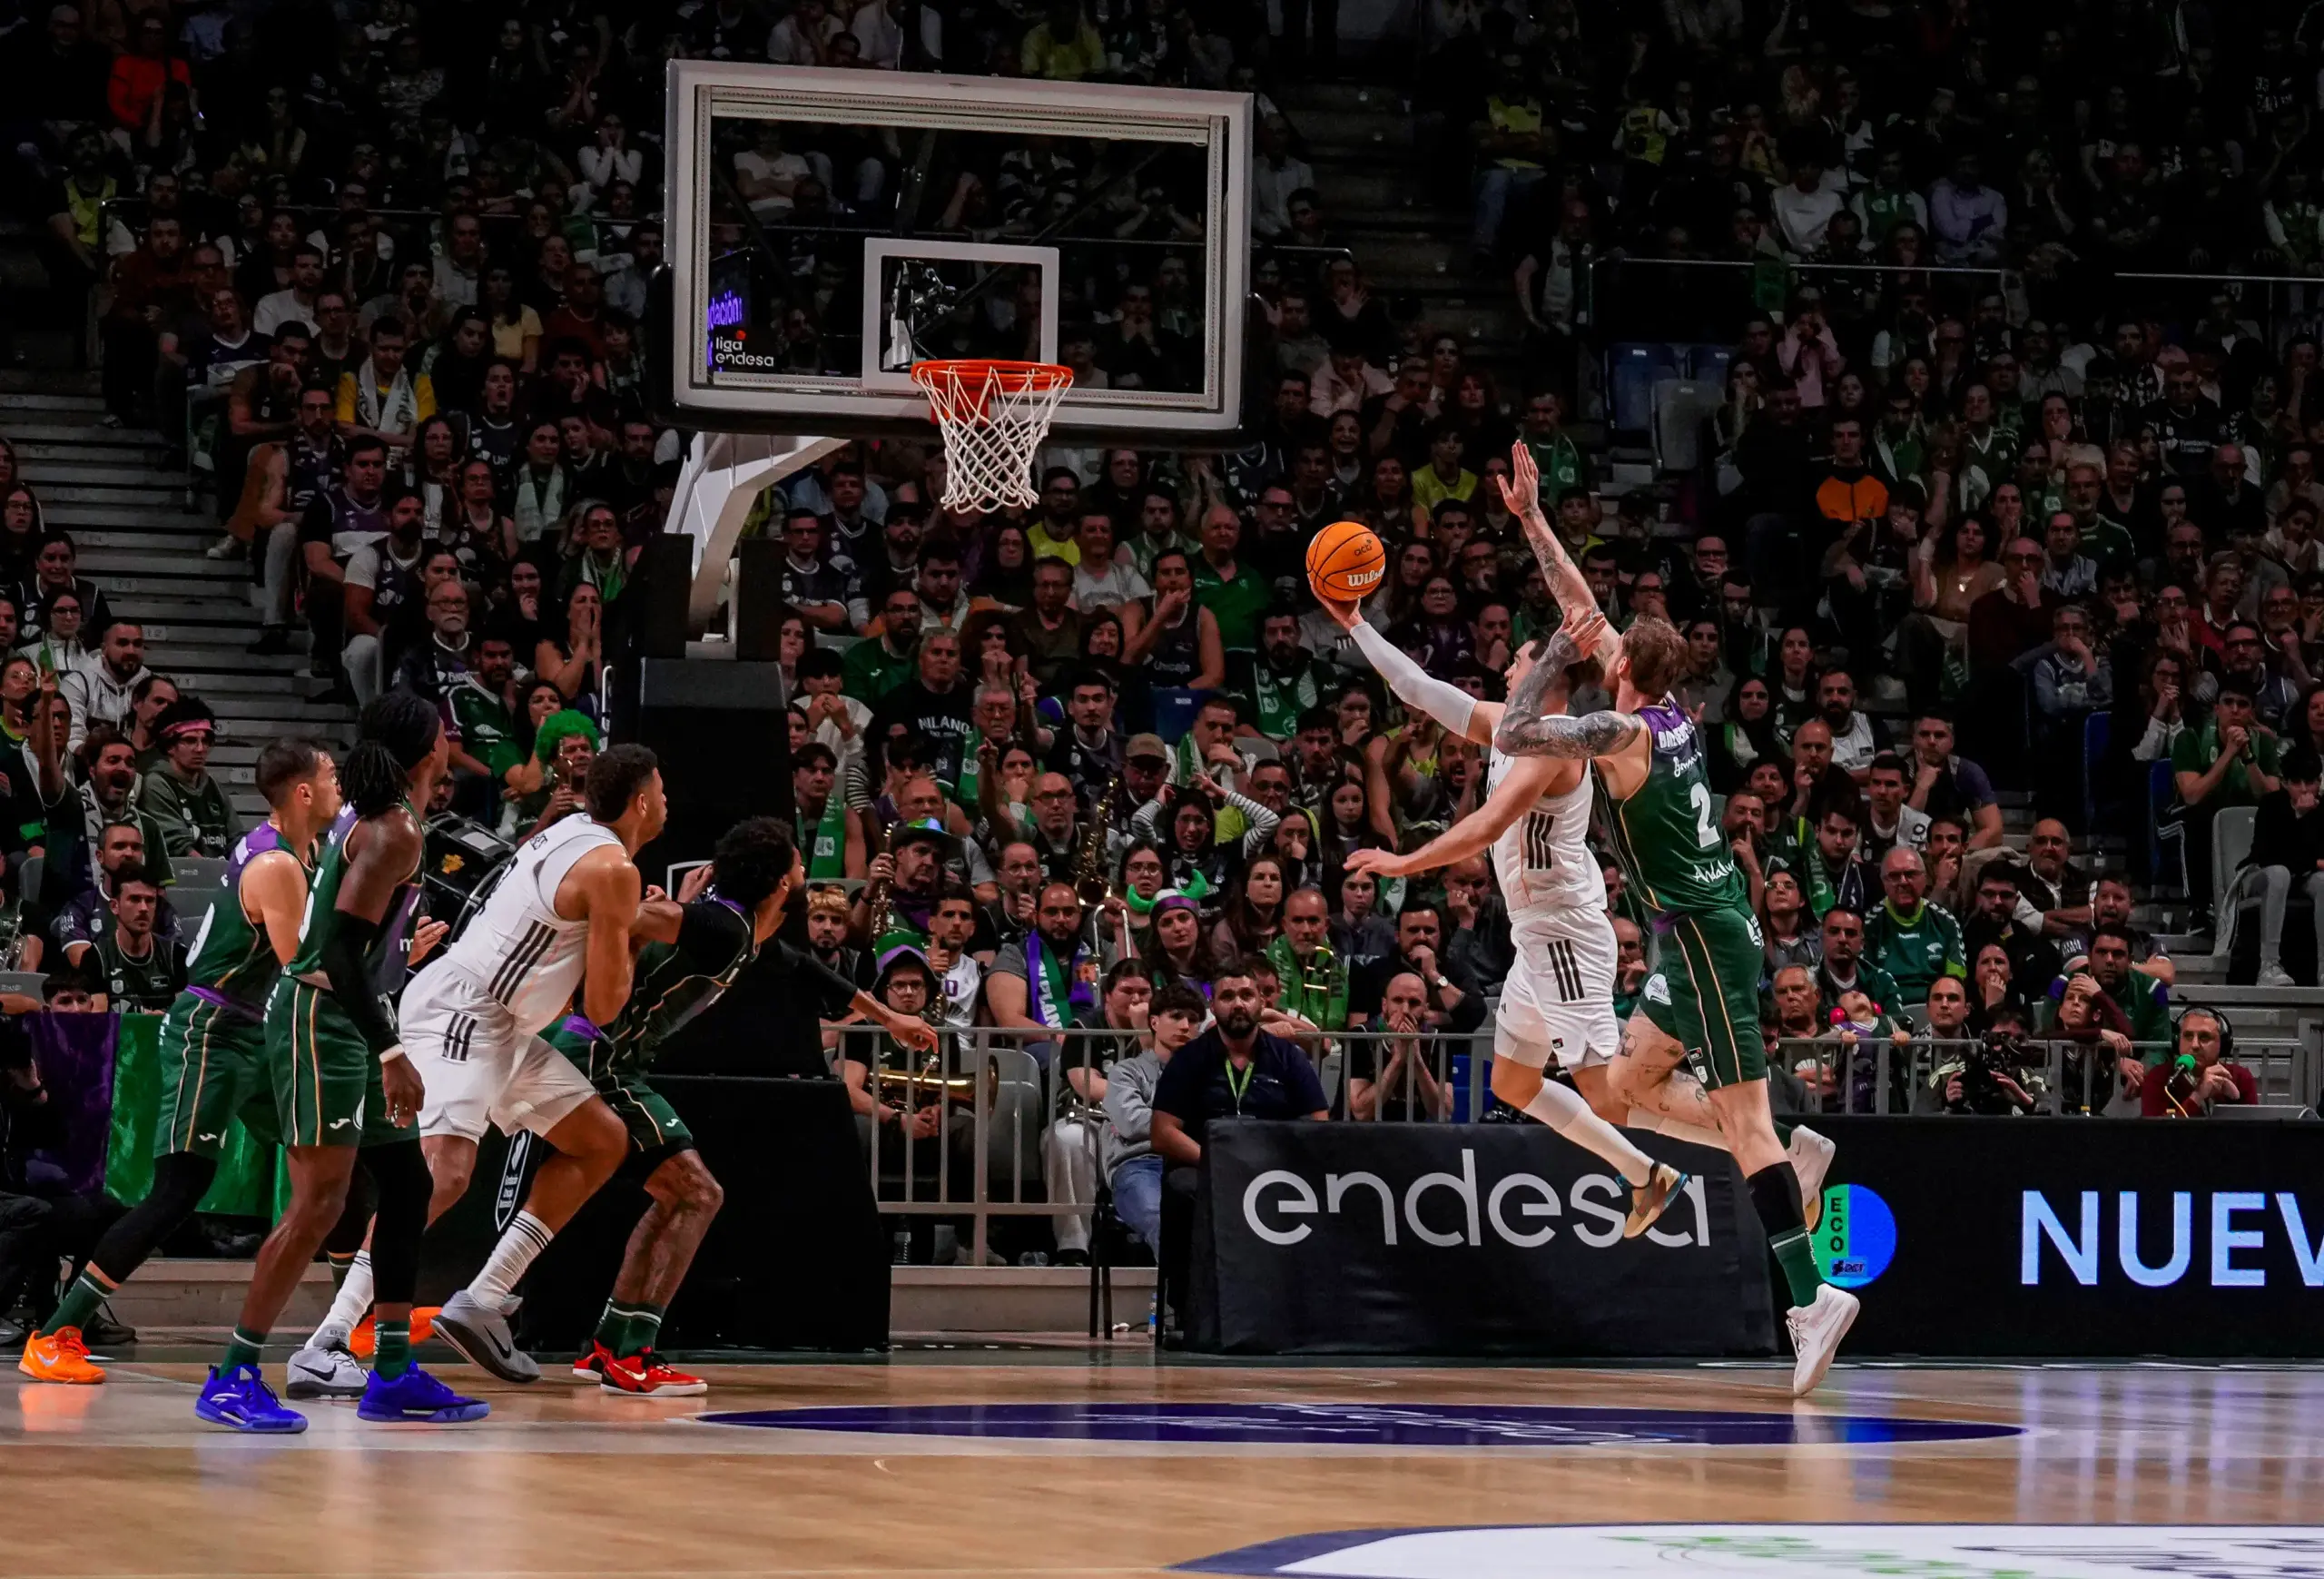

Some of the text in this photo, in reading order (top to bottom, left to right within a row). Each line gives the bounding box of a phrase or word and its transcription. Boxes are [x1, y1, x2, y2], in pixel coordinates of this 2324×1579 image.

[714, 351, 775, 367] endesa
[715, 336, 743, 352] liga
[1690, 782, 1721, 848] 2
[1243, 1148, 1710, 1248] endesa
[1830, 1197, 1845, 1252] ECO
